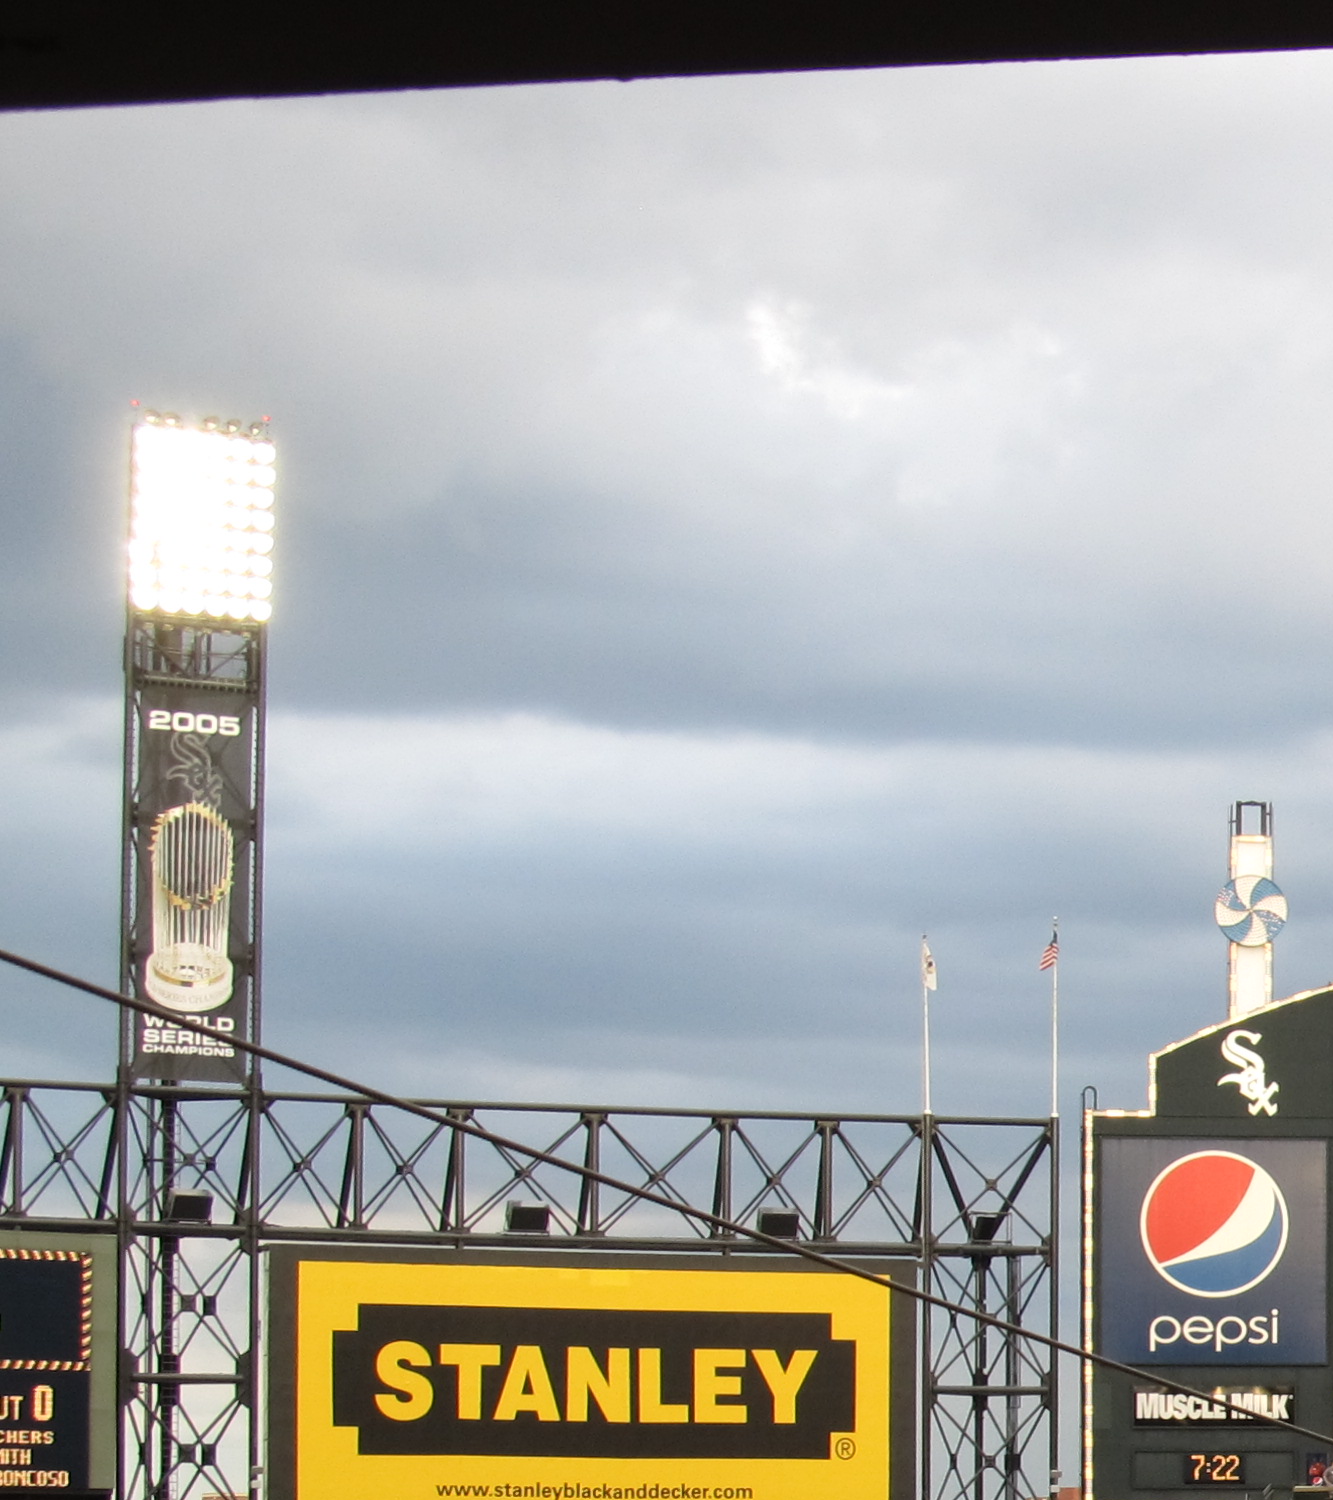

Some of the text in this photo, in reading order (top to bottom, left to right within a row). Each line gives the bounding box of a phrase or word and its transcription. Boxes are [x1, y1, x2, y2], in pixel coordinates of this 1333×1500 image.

[149, 710, 241, 736] 2005
[142, 1043, 235, 1058] CHAMPIONS
[1149, 1308, 1279, 1352] pepsi
[374, 1340, 819, 1425] STANLEY
[1136, 1393, 1289, 1421] MUSCLE MILK
[1191, 1454, 1241, 1480] 7:22
[436, 1482, 753, 1500] www.stanleyblackanddecker.com
